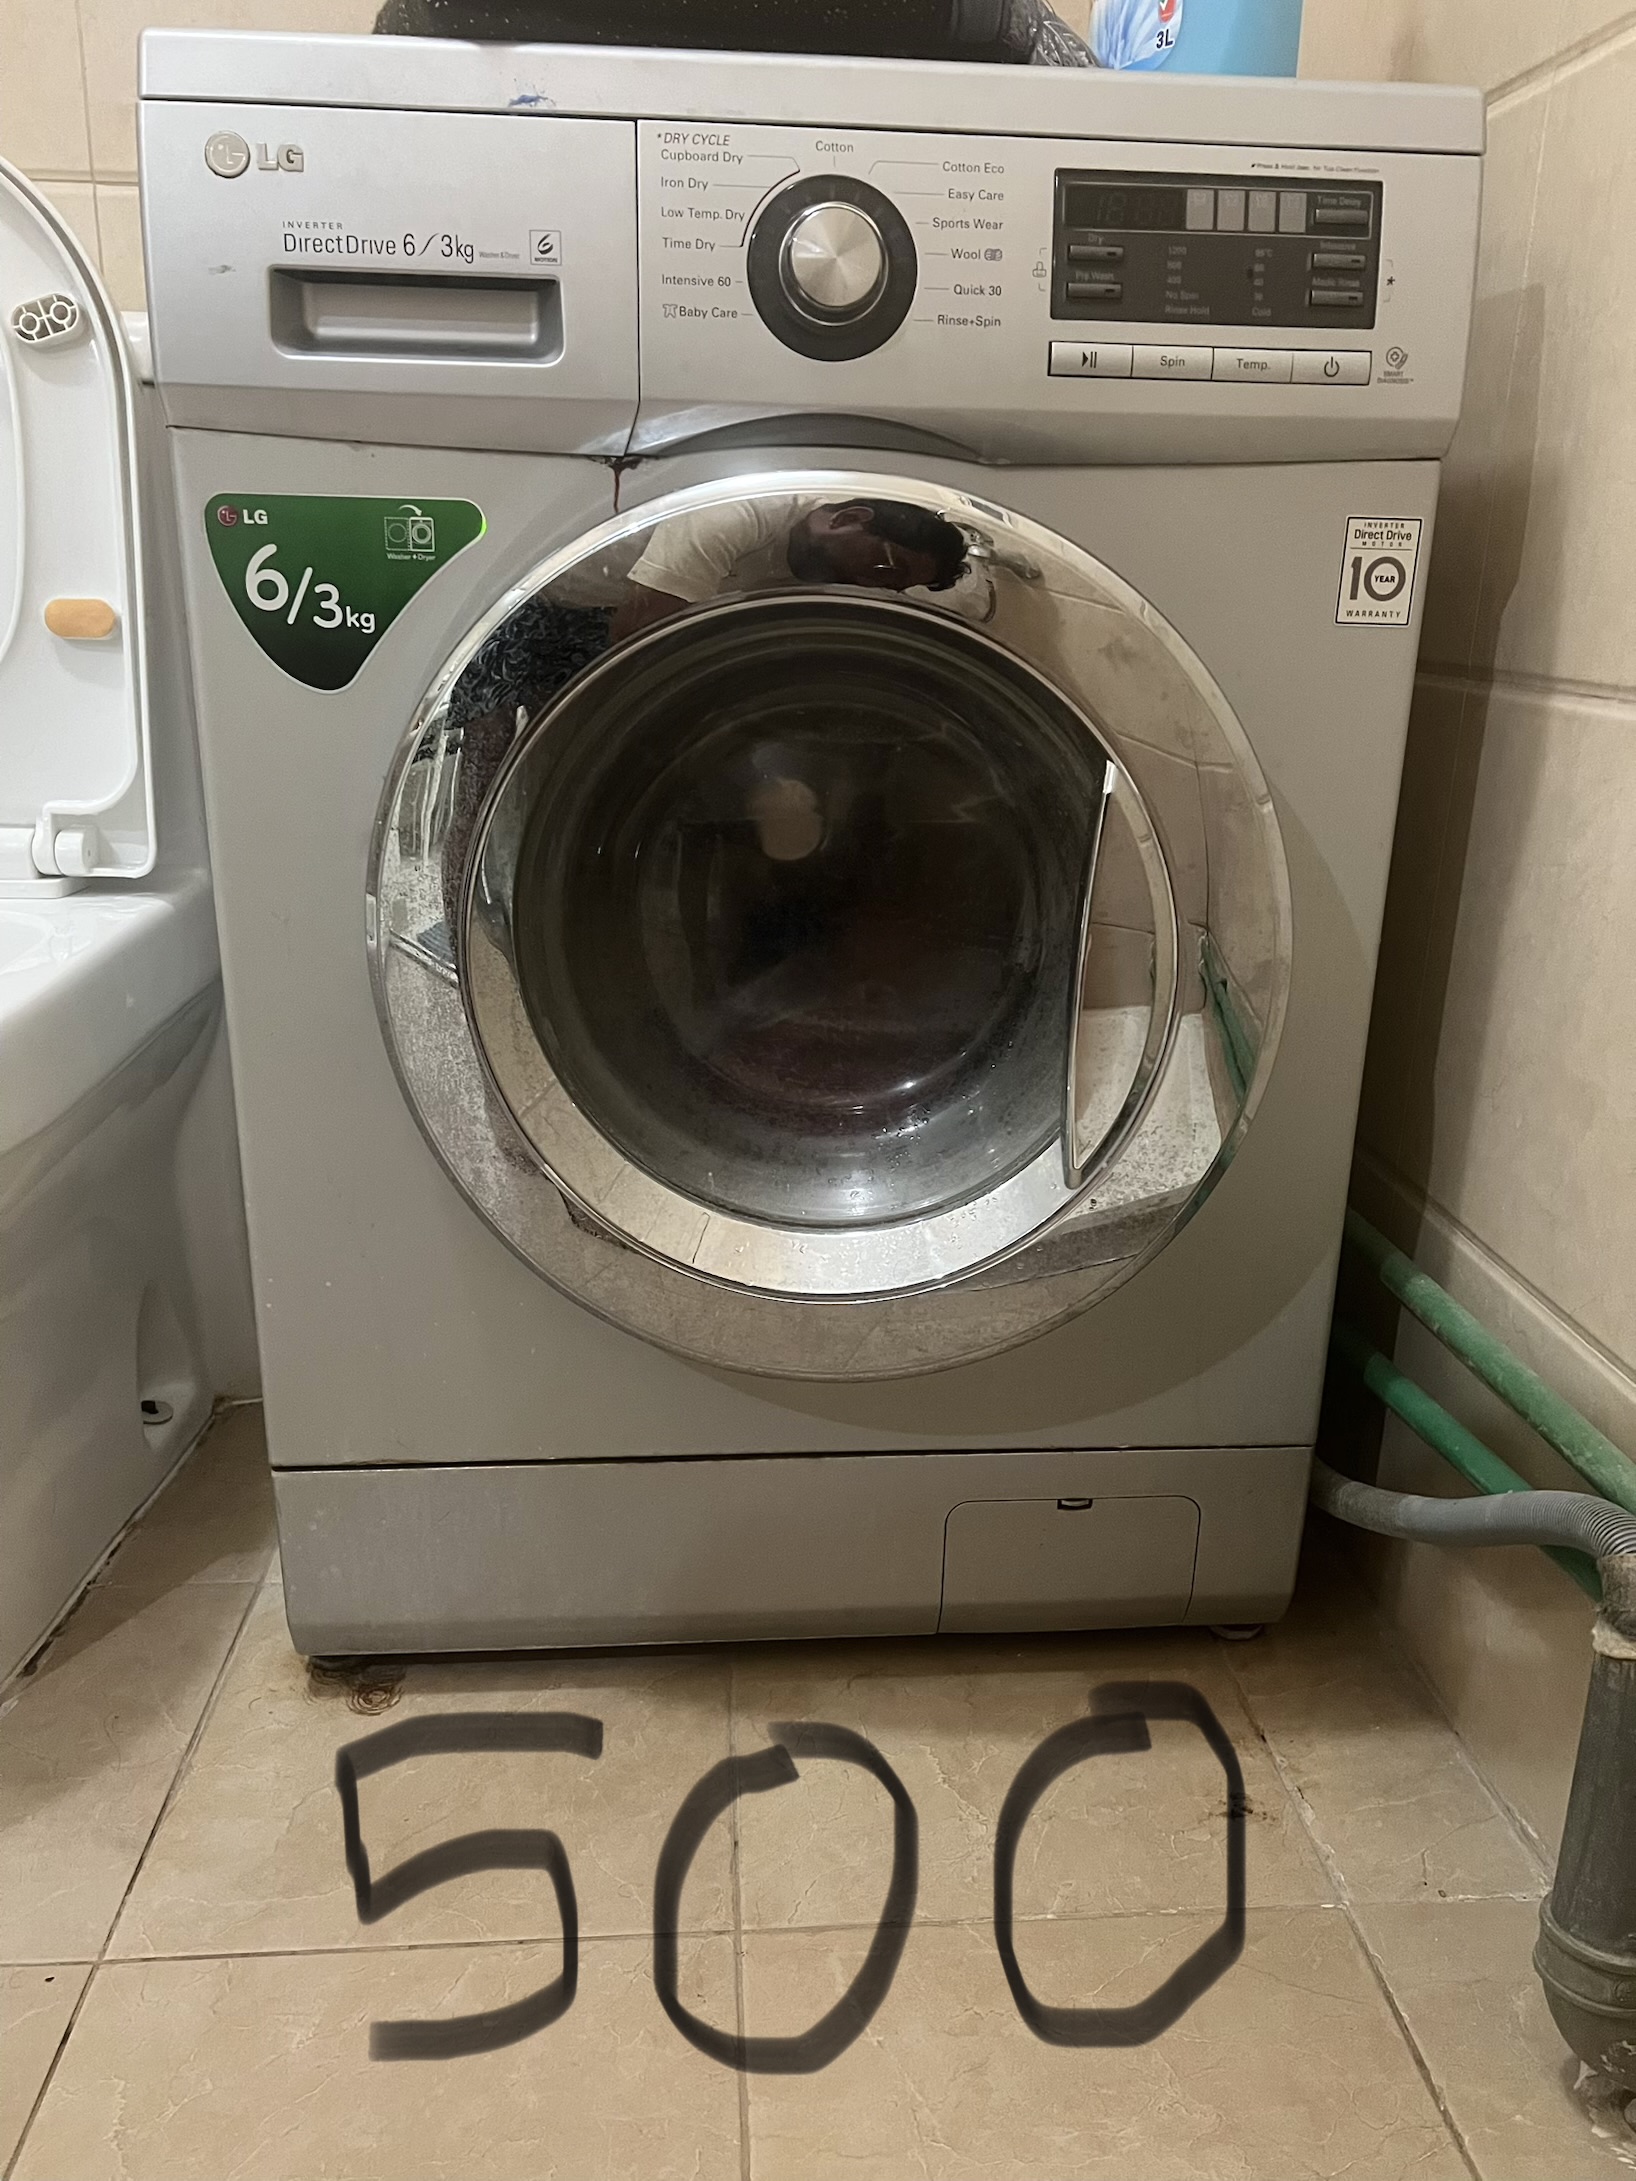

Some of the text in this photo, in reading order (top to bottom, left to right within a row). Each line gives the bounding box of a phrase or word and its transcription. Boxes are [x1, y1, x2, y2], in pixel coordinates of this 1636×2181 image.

[1156, 28, 1174, 49] 3L
[692, 133, 731, 146] CYCLE
[815, 139, 854, 153] Cotton
[256, 142, 304, 173] LG
[660, 148, 743, 165] Cupboard Dry
[942, 160, 1005, 174] Cotton Eco
[660, 176, 708, 192] Iron Dry
[948, 188, 1004, 202] Easy Care
[660, 206, 745, 222] Low Temp. Dry
[282, 220, 344, 230] INVERTER
[932, 216, 1004, 231] Sports Wear
[661, 236, 716, 252] Time Dry
[950, 247, 981, 260] Wool
[661, 273, 732, 287] Intensive 60
[953, 283, 1002, 297] Quick 30
[679, 305, 738, 319] Baby Care
[937, 314, 1002, 329] Rinse+Spin
[1159, 355, 1186, 368] Spin
[1236, 358, 1271, 371] Temp.
[243, 509, 268, 525] LG
[1354, 529, 1412, 541] Direct Drive
[1349, 556, 1406, 602] 10
[1374, 575, 1396, 584] YEAR
[1346, 609, 1401, 618] WARRANTY
